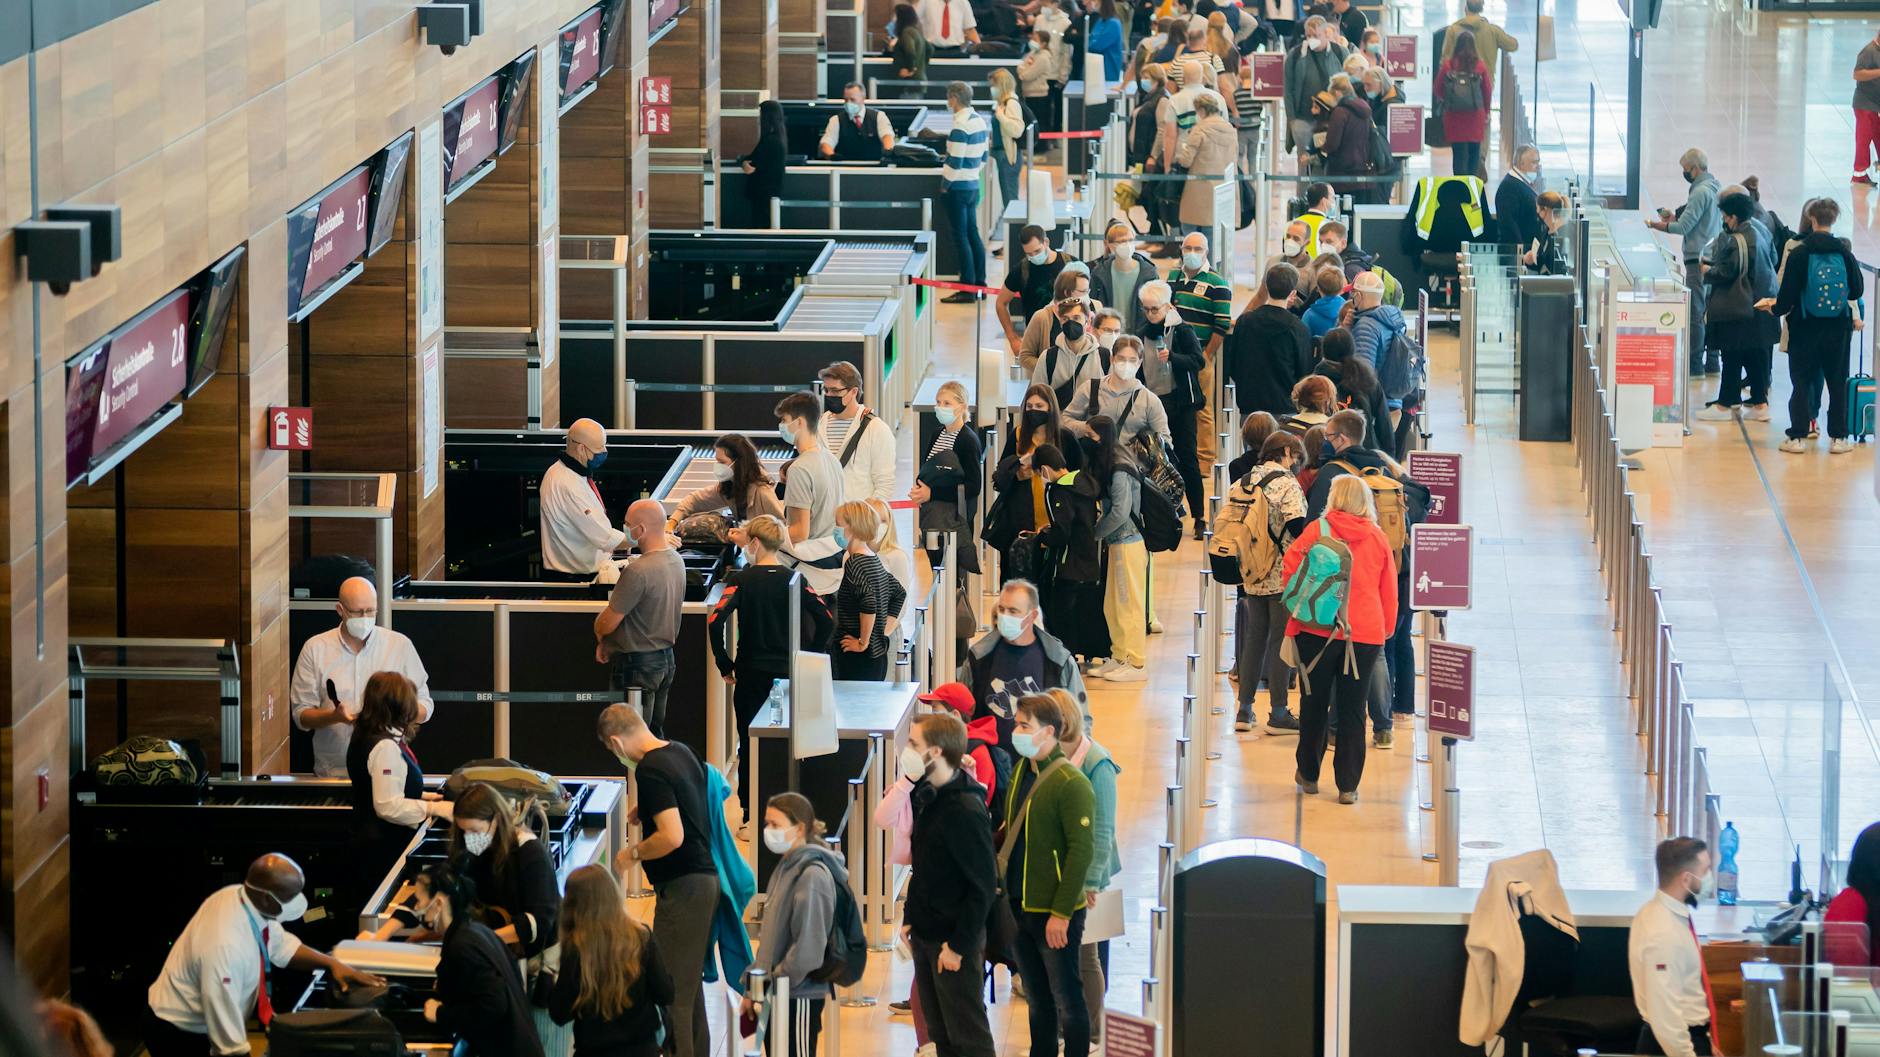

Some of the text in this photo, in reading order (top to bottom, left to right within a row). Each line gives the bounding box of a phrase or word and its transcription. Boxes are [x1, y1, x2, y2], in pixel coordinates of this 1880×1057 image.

[356, 194, 366, 232] 2.7
[171, 323, 185, 368] 2.8
[112, 341, 154, 388] Sicherheitskontrolle
[112, 378, 138, 413] Security Control
[476, 693, 492, 701] BER
[576, 693, 592, 701] BER
